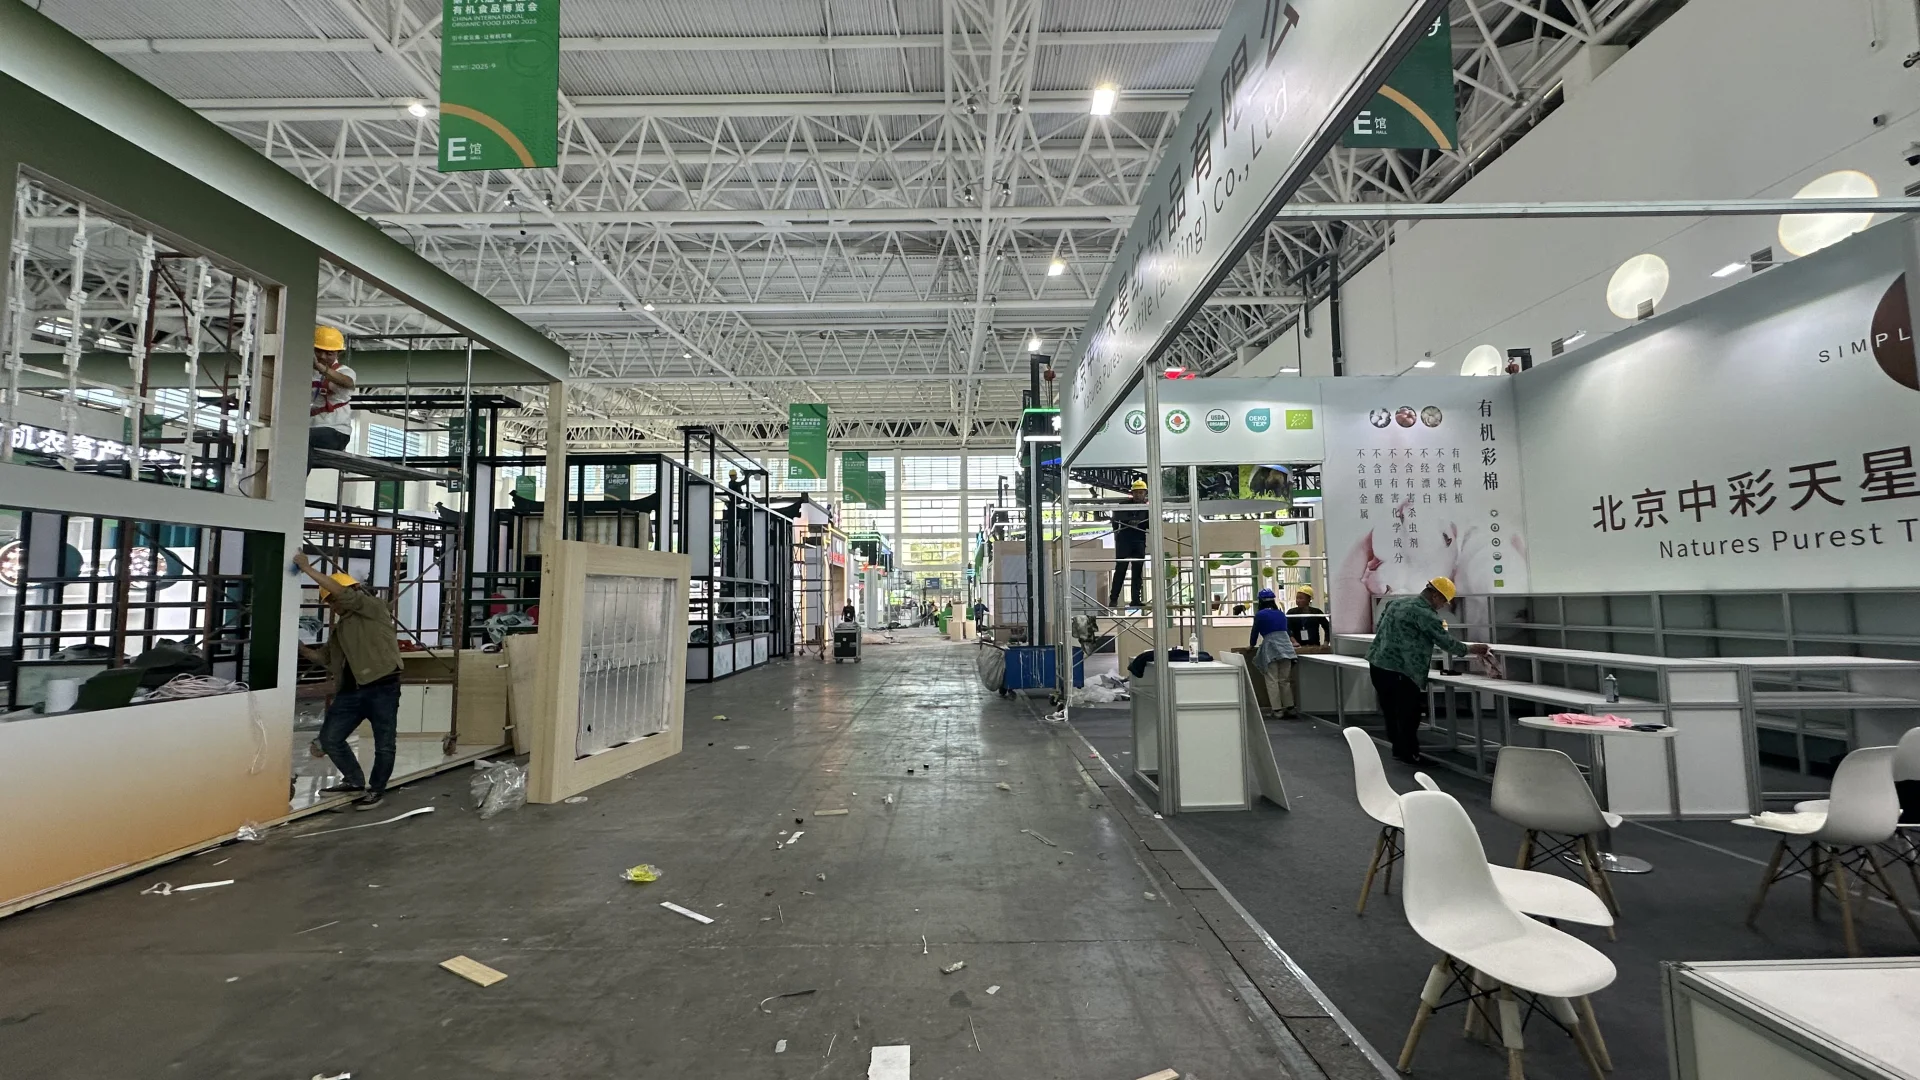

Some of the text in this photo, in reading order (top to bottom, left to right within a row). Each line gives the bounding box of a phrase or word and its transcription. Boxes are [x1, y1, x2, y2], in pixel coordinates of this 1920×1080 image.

[452, 2, 538, 15] 有机食品博览会
[448, 138, 482, 161] E 馆
[1353, 110, 1387, 134] E 馆
[1818, 328, 1911, 363] SIMPL
[1477, 399, 1498, 491] 有机彩棉
[1356, 448, 1369, 520] 不含重金属
[1372, 448, 1384, 504] 不含甲醛
[1404, 448, 1419, 549] 不含有害杀虫剂
[1420, 448, 1431, 504] 不经漂白
[1436, 448, 1447, 504] 不含染料
[1452, 447, 1463, 504] 有机种植
[1592, 446, 1920, 533] 北京中彩天星
[1388, 448, 1403, 564] 不含有害化学成分
[1659, 537, 1760, 559] Natures
[1772, 522, 1884, 551] Purest
